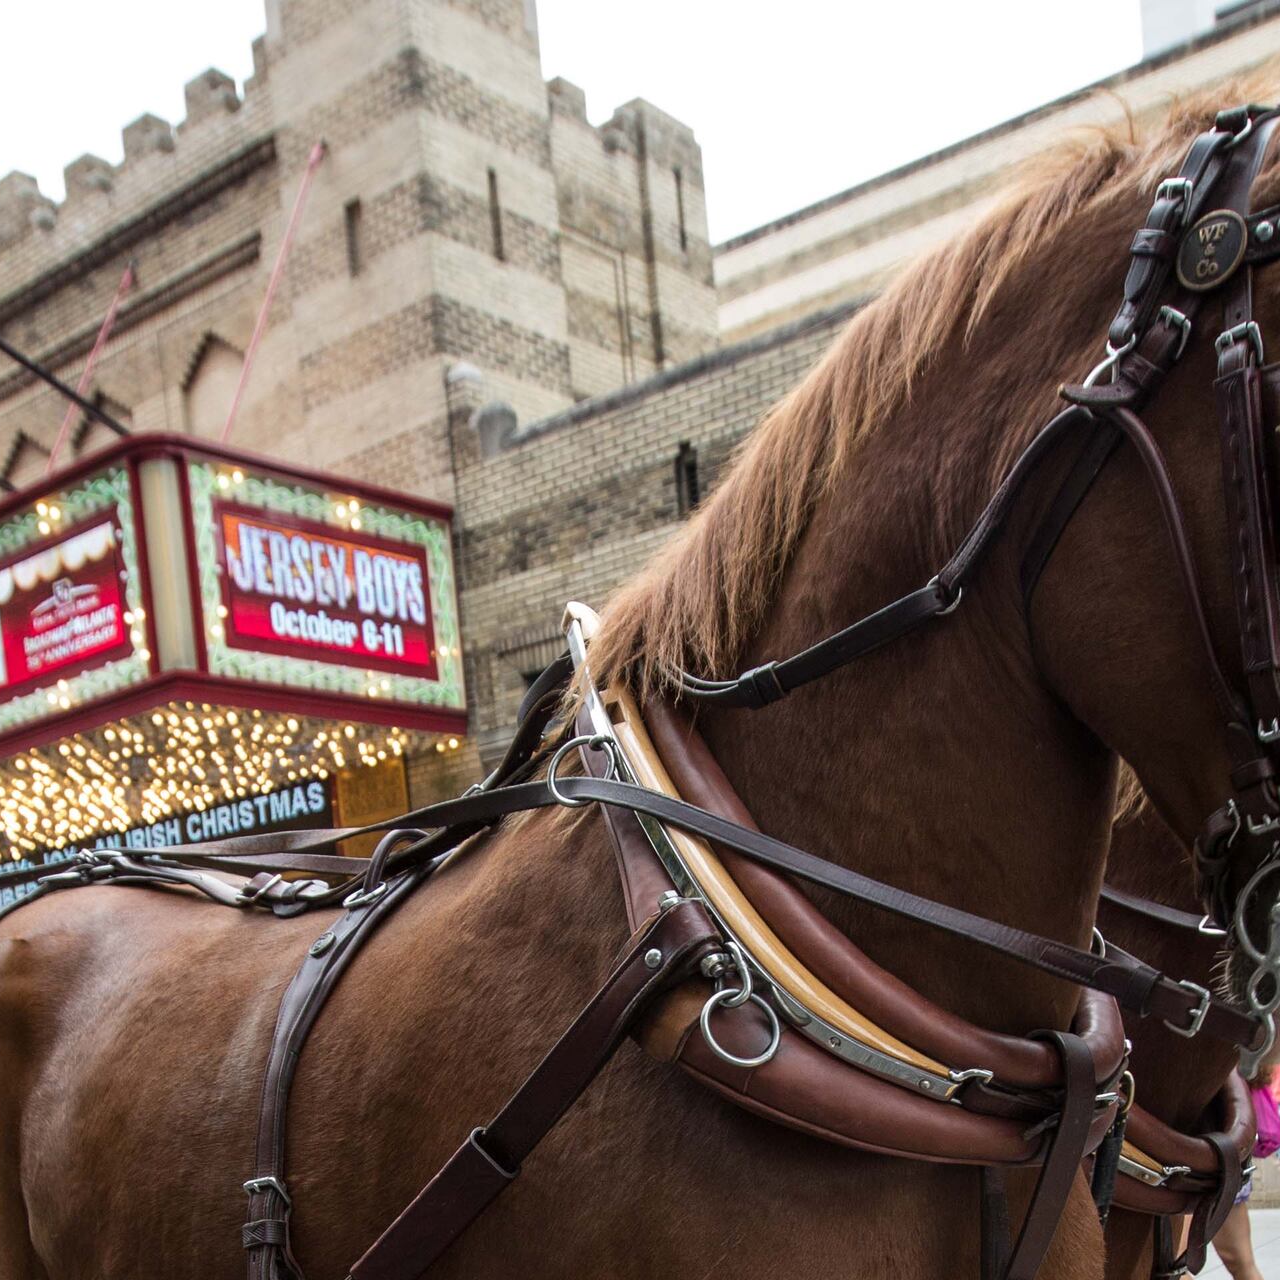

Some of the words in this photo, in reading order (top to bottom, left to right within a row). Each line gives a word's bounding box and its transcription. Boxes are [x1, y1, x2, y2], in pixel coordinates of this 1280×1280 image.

[1199, 220, 1229, 244] WF
[1204, 243, 1216, 256] &
[1196, 258, 1218, 278] Co
[229, 522, 348, 609] JERSEY
[352, 549, 426, 626] BOYS
[269, 601, 359, 648] October
[361, 618, 405, 657] 6-11
[125, 817, 183, 849] IRISH
[185, 781, 326, 841] CHRISTMAS
